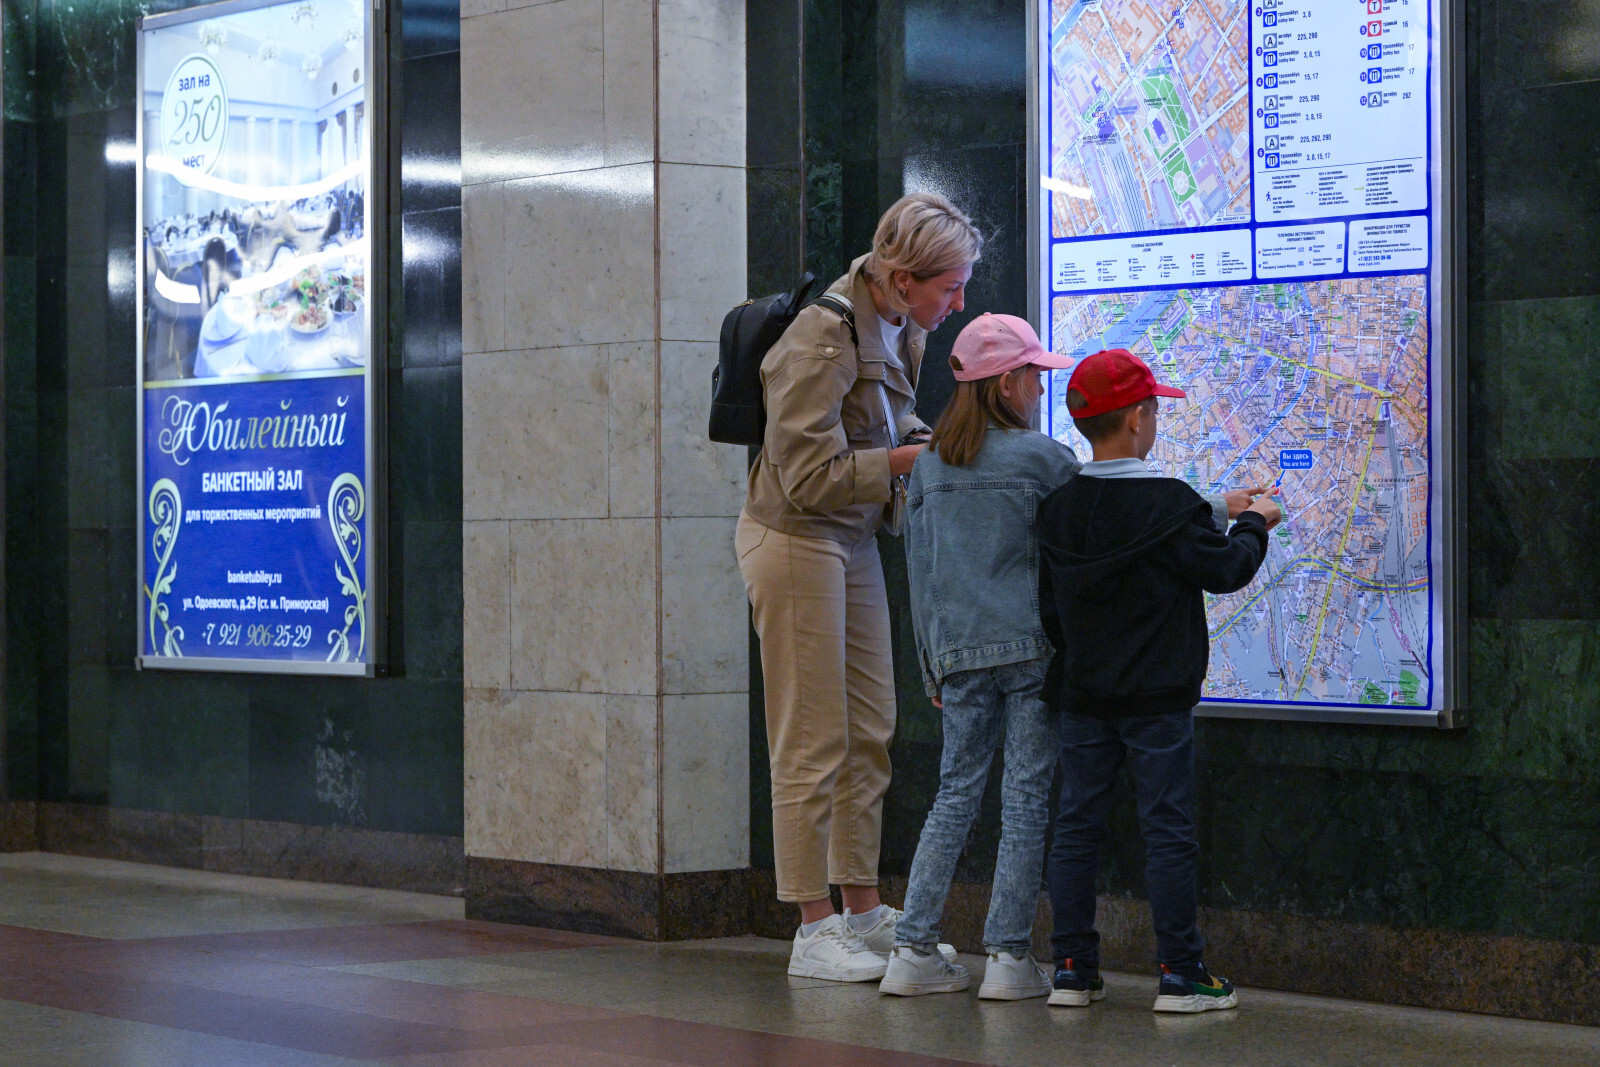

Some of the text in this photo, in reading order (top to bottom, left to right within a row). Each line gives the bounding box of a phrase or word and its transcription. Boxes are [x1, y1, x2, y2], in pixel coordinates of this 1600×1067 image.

[178, 74, 210, 91] зал на
[169, 94, 220, 145] 250
[183, 154, 205, 168] мест
[159, 394, 348, 466] Юбилейный
[202, 468, 302, 492] БАНКЕТНЫЙ ЗАЛ
[186, 504, 320, 524] для торжественных мероприятий
[228, 570, 282, 586] banketubiley.ru
[183, 598, 194, 611] ул.
[195, 595, 238, 611] Одоевского,
[258, 596, 269, 612] (ст.
[270, 600, 278, 609] м.
[280, 596, 329, 613] Приморская)
[218, 623, 242, 646] 921
[246, 624, 312, 648] 906-25-29
